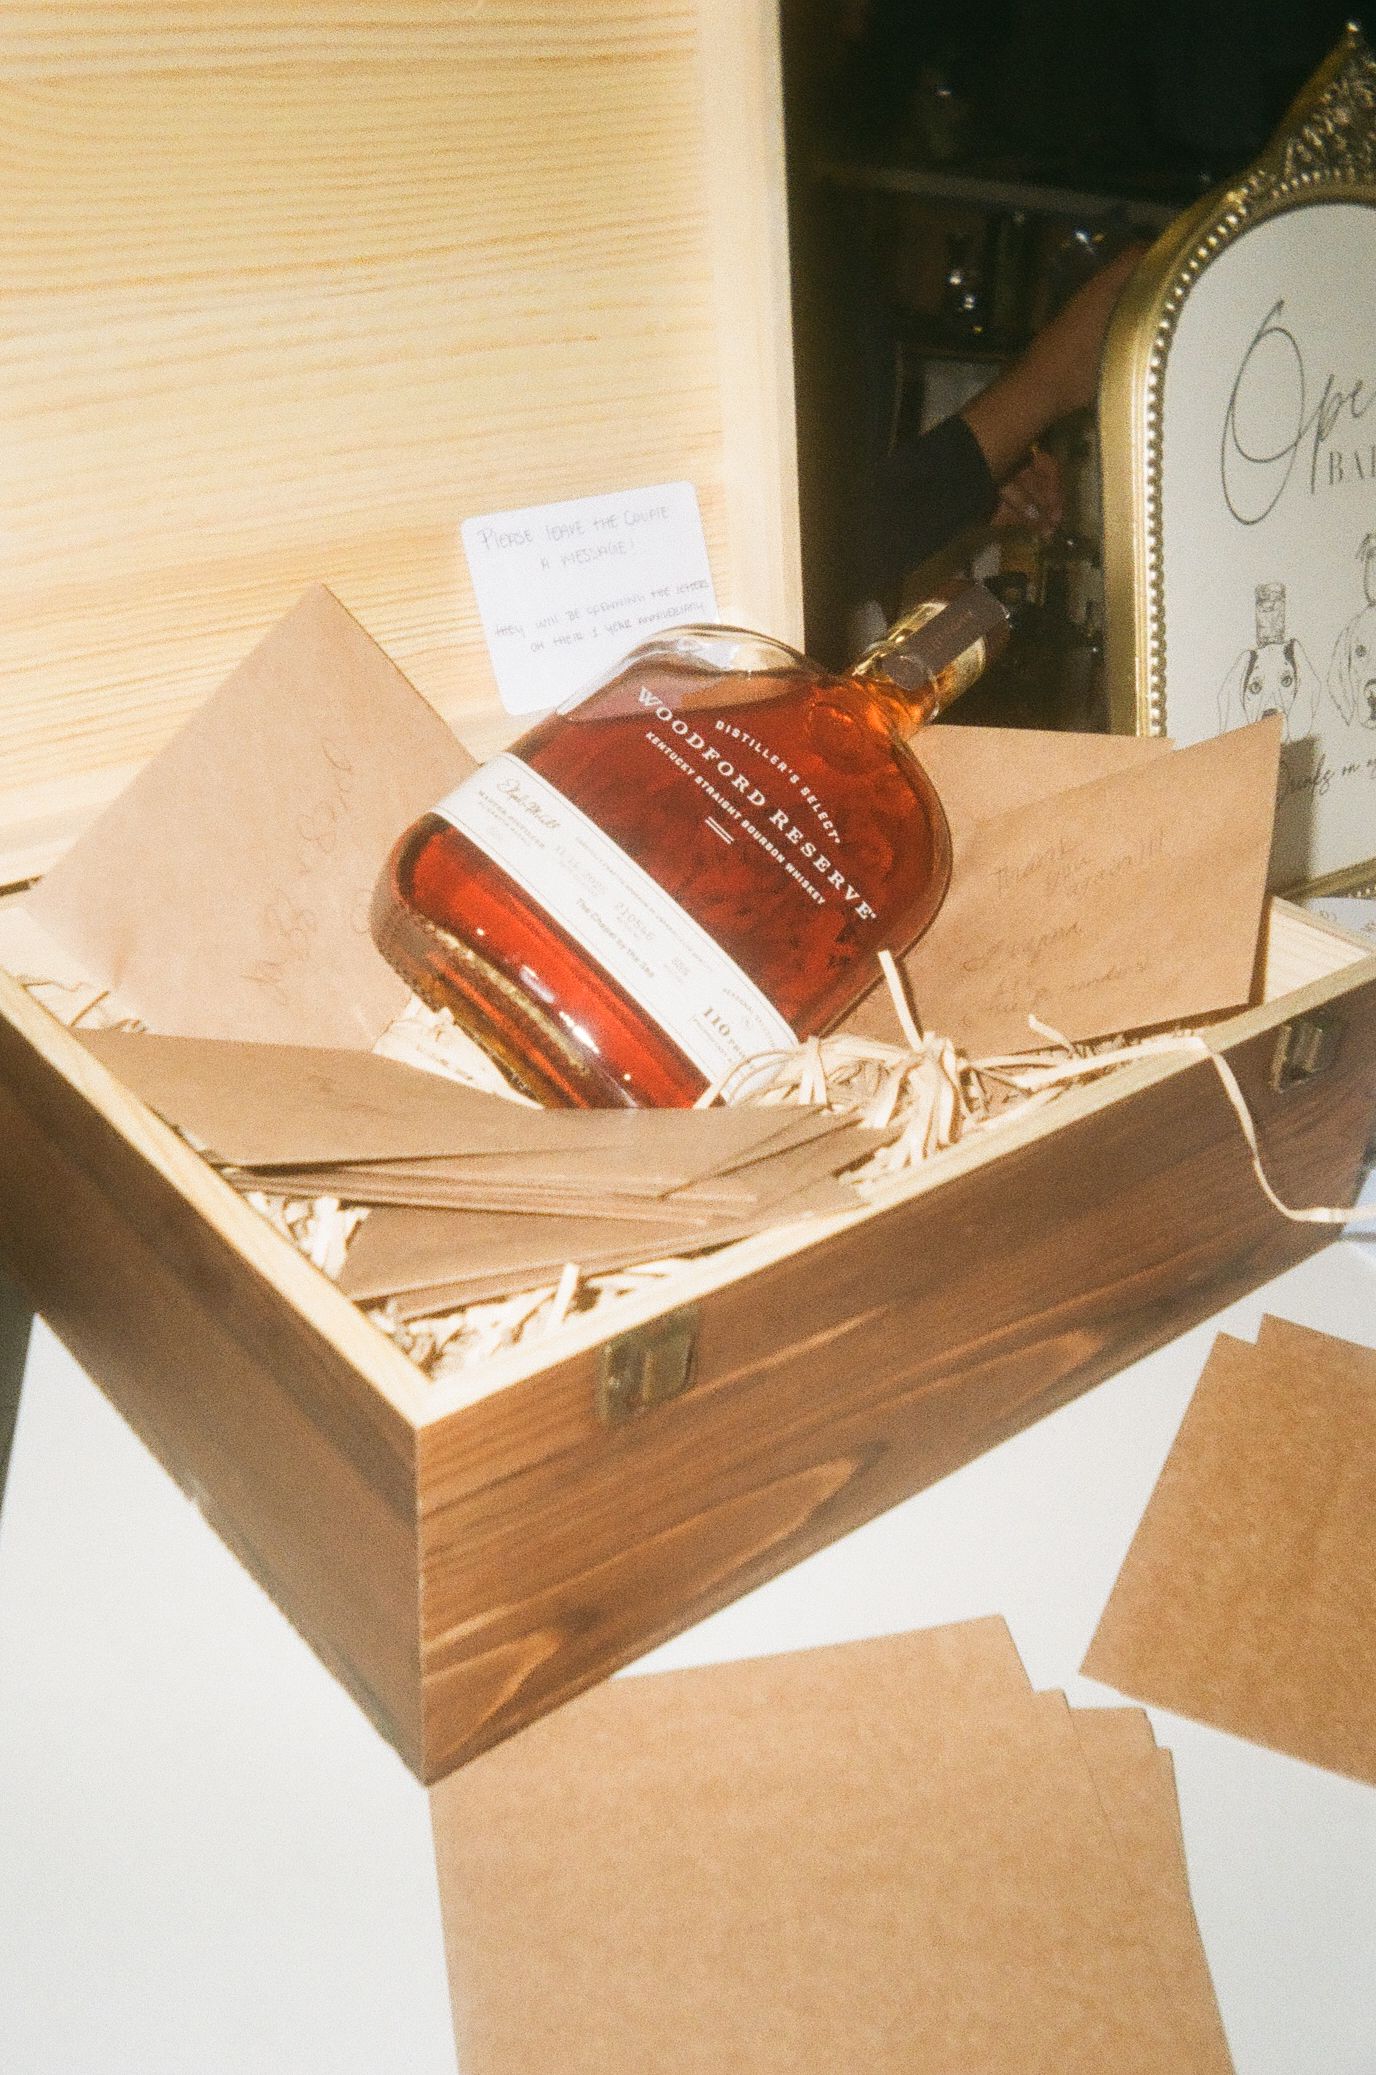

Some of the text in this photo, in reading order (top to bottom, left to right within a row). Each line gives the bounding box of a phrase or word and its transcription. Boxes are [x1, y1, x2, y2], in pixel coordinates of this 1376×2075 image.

[1329, 445, 1376, 485] BA
[637, 686, 766, 806] WOODFORD
[714, 719, 800, 785] DISTILLER'S
[645, 731, 826, 905] KENTUCKY STRAIGHT BOURBON WHISKEY
[704, 1005, 731, 1037] 110
